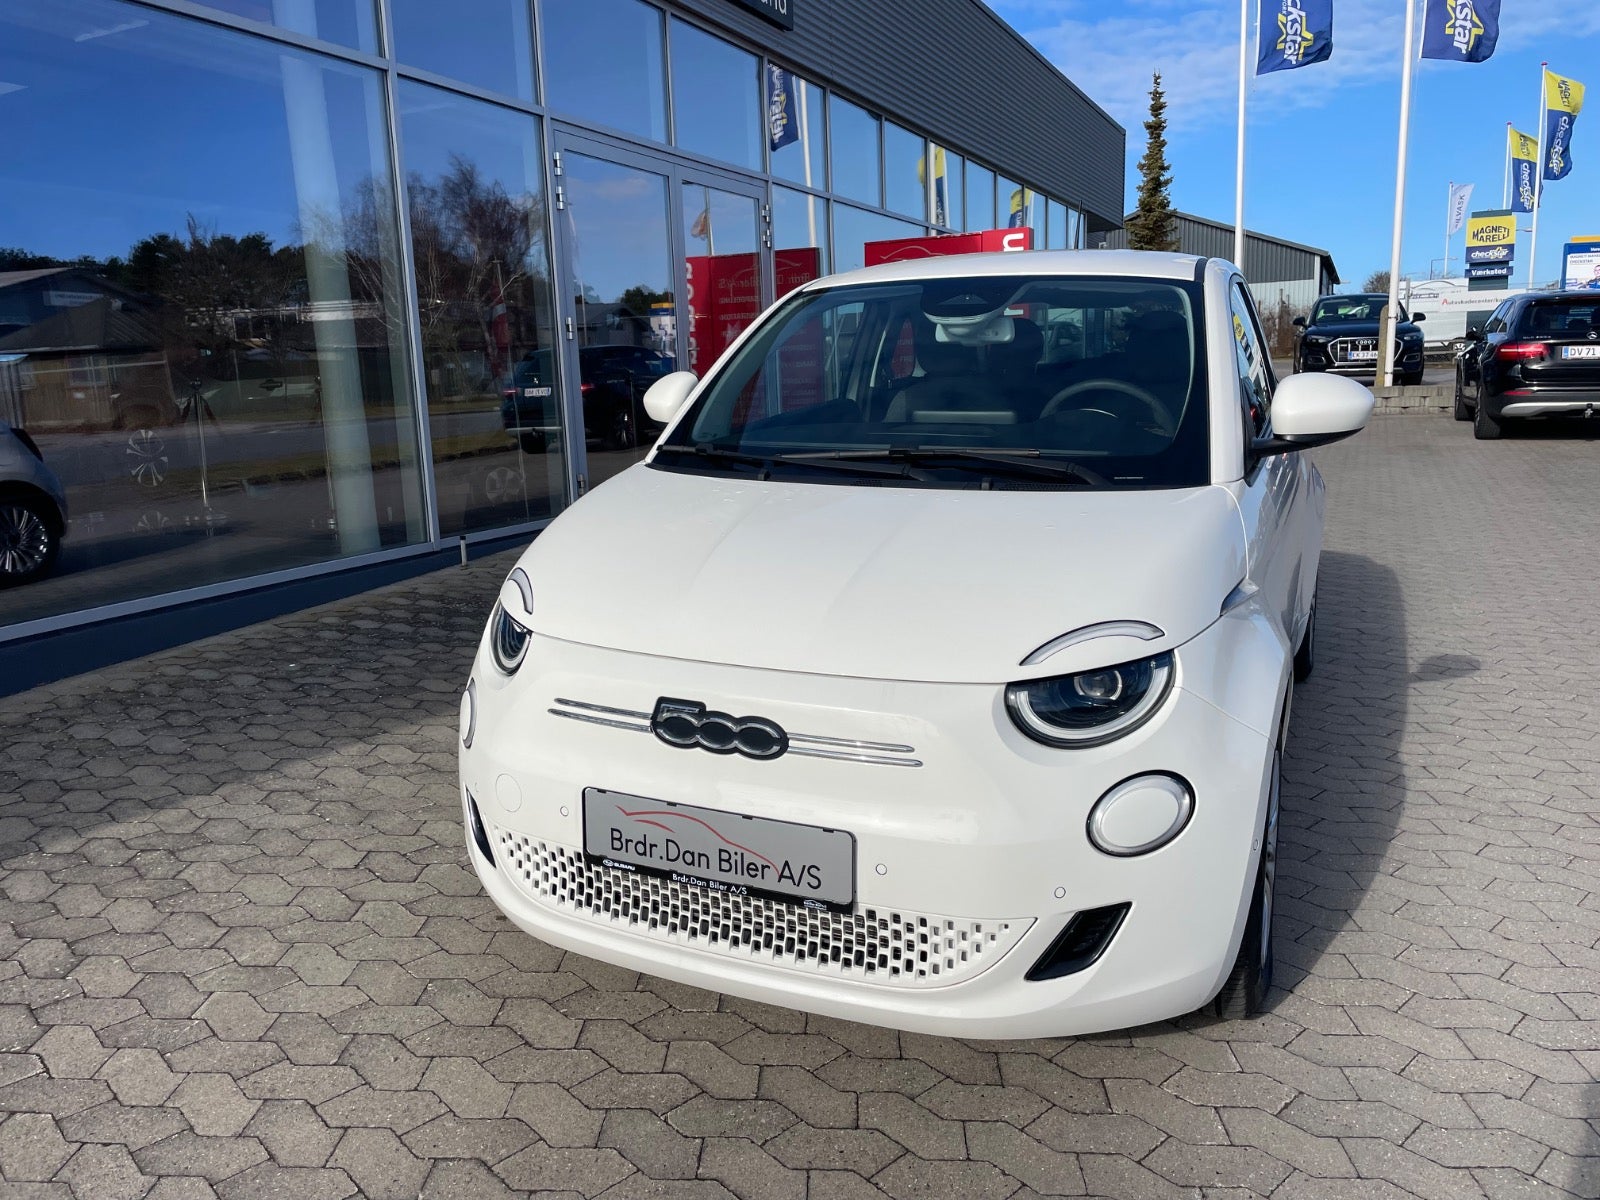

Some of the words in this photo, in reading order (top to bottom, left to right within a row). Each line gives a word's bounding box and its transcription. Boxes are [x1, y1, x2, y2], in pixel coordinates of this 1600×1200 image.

[1471, 247, 1509, 258] checkstar
[1471, 268, 1507, 276] Værksted
[1570, 348, 1583, 356] DV
[1586, 347, 1596, 356] 71
[651, 696, 789, 761] 500
[610, 827, 710, 869] Brdr.Dan
[718, 848, 771, 880] Biler
[777, 860, 822, 890] A/S
[614, 862, 636, 871] SUBARU
[672, 872, 707, 888] Brdr.Dan
[709, 880, 728, 892] Biler
[730, 884, 748, 895] A/S
